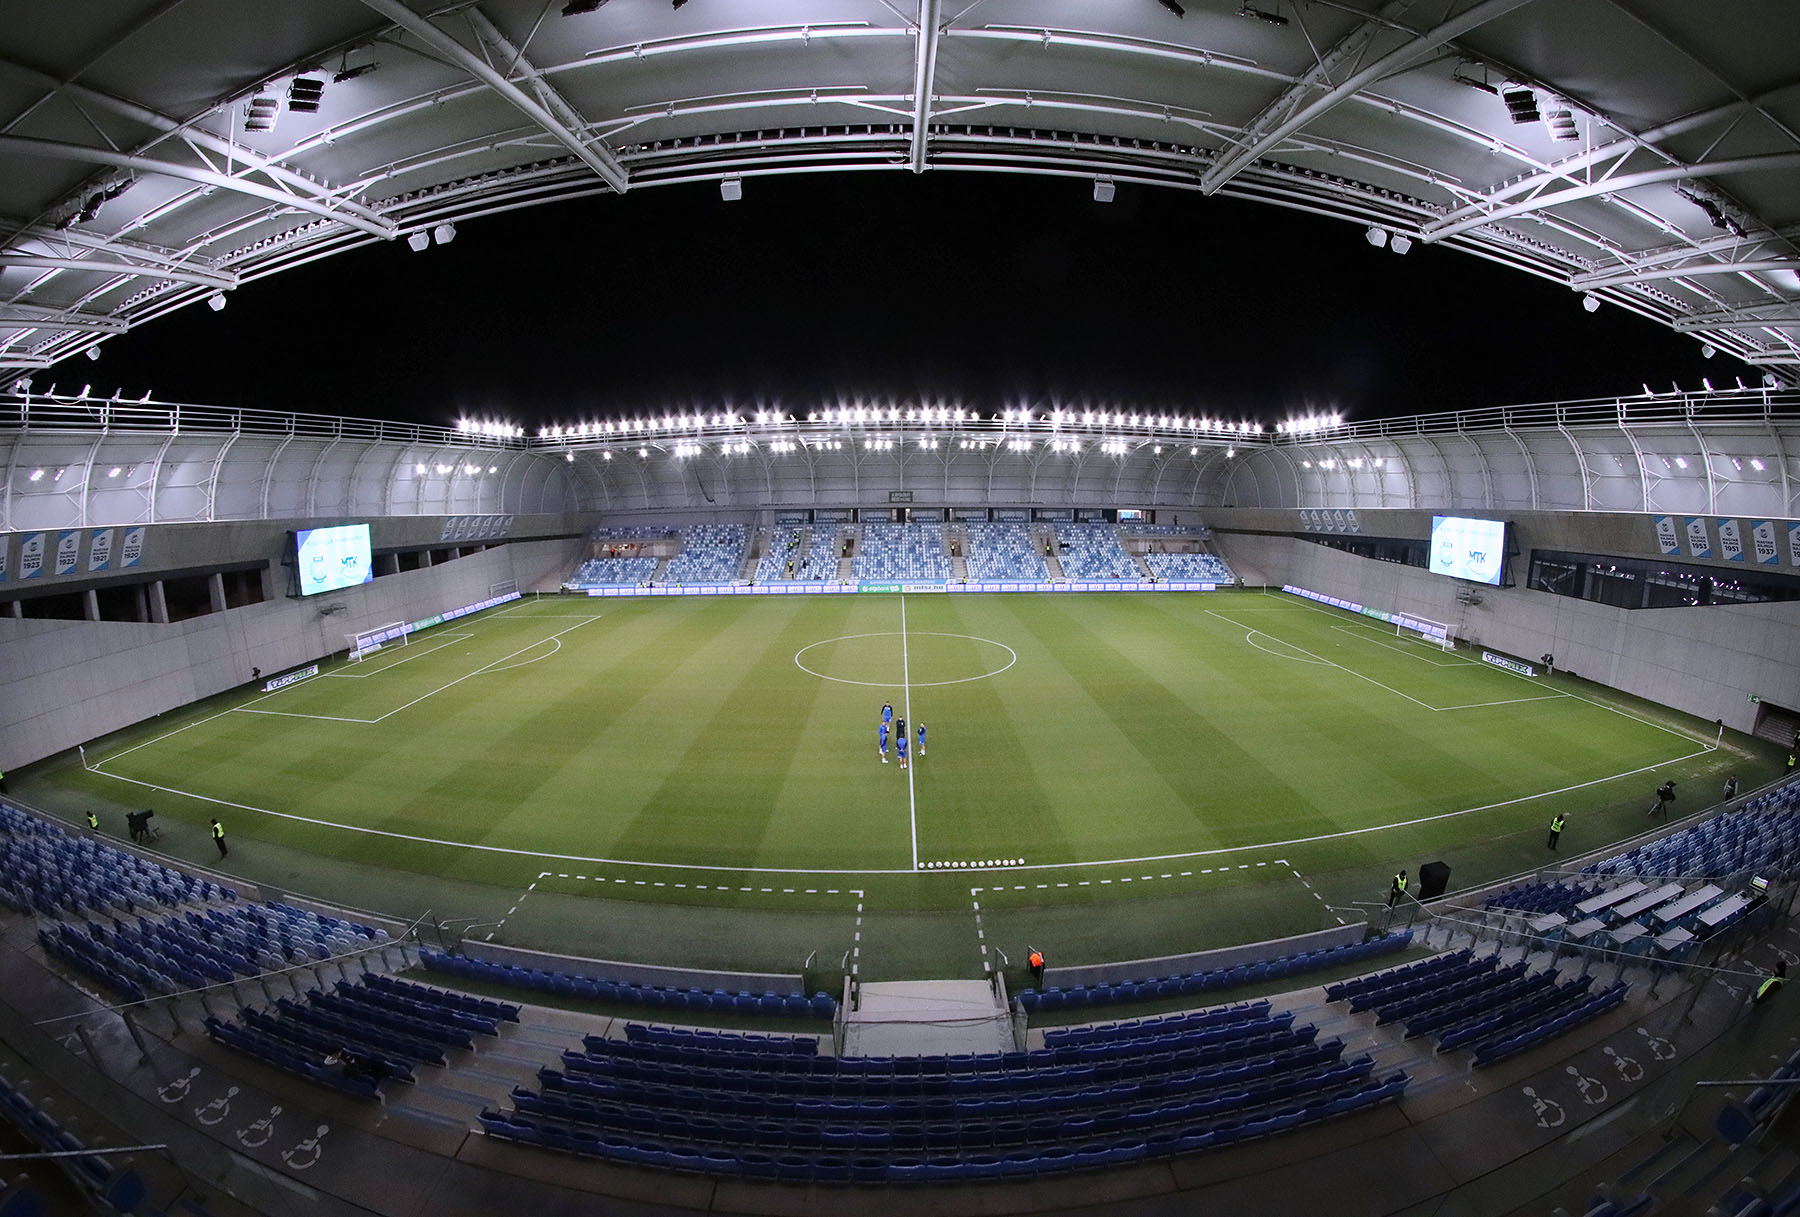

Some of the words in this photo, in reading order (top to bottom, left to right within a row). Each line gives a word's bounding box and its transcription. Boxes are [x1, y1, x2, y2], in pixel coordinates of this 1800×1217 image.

[341, 556, 358, 568] MTK
[1469, 550, 1487, 563] MTK
[23, 561, 40, 569] 1923
